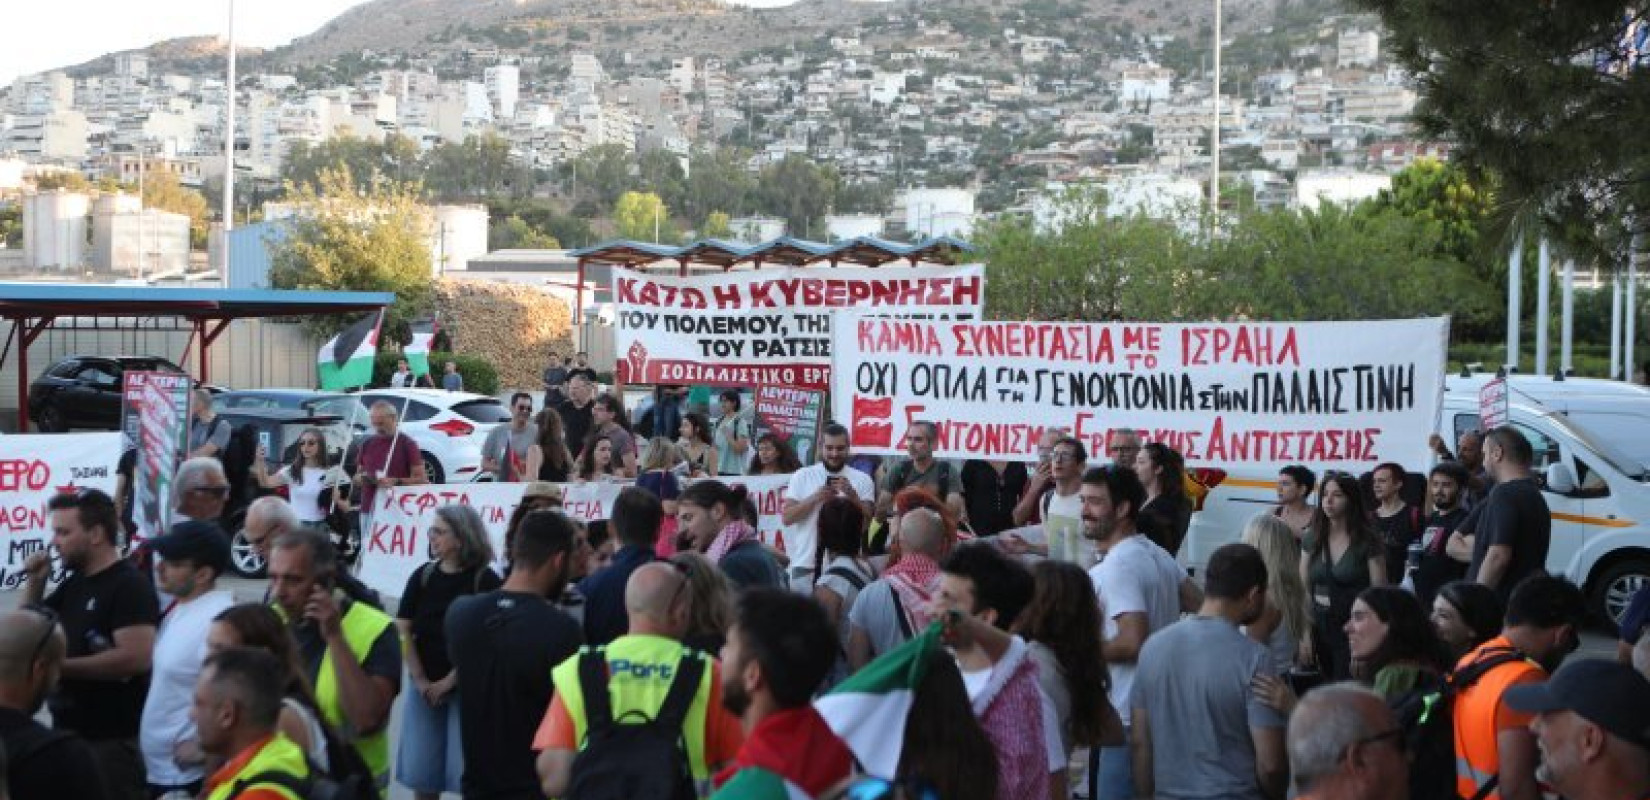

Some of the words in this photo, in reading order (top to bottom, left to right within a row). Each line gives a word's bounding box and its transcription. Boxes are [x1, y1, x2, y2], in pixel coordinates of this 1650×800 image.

[617, 278, 708, 309] ΚΑΤΩ
[712, 284, 741, 309] Η
[749, 276, 980, 308] ΚΥΒΕΡΝΗΣΗ
[620, 311, 658, 330] ΤΟΥ
[664, 314, 788, 336] ΠΟΛΕΜΟΥ,
[857, 320, 942, 354] ΚΑΜΙΑ
[1123, 326, 1162, 350] ΜΕ
[698, 339, 745, 358] ΤΟΥ
[752, 338, 829, 358] ΡΑΤΣΙΣ
[952, 324, 1114, 363] ΣΥΝΕΡΓΑΣΙΑ
[1181, 325, 1301, 366] ΙΣΡΑΗΛ
[661, 363, 795, 384] ΣΟΣΙΑΛΙΣΤΙΚΟ
[803, 367, 829, 384] ΕΡΓ
[856, 361, 897, 396] ΟΧΙ
[995, 366, 1029, 384] ΓΙΑ
[1126, 353, 1157, 370] ΤΟ
[910, 362, 988, 402] ΟΠΛΑ
[998, 388, 1024, 402] ΤΗ
[1034, 367, 1195, 412] ΓΕΝΟΚΤΟΝΙΑ
[1251, 362, 1415, 415] ΠΑΛΑΙΣΤΙΝΗ
[896, 405, 1071, 456] ΣΝΤΟΝΙΣΜ
[1205, 416, 1381, 462] ΑΝΤΙΣΤΑΣΗΣ
[368, 522, 417, 557] ΚΑΙ
